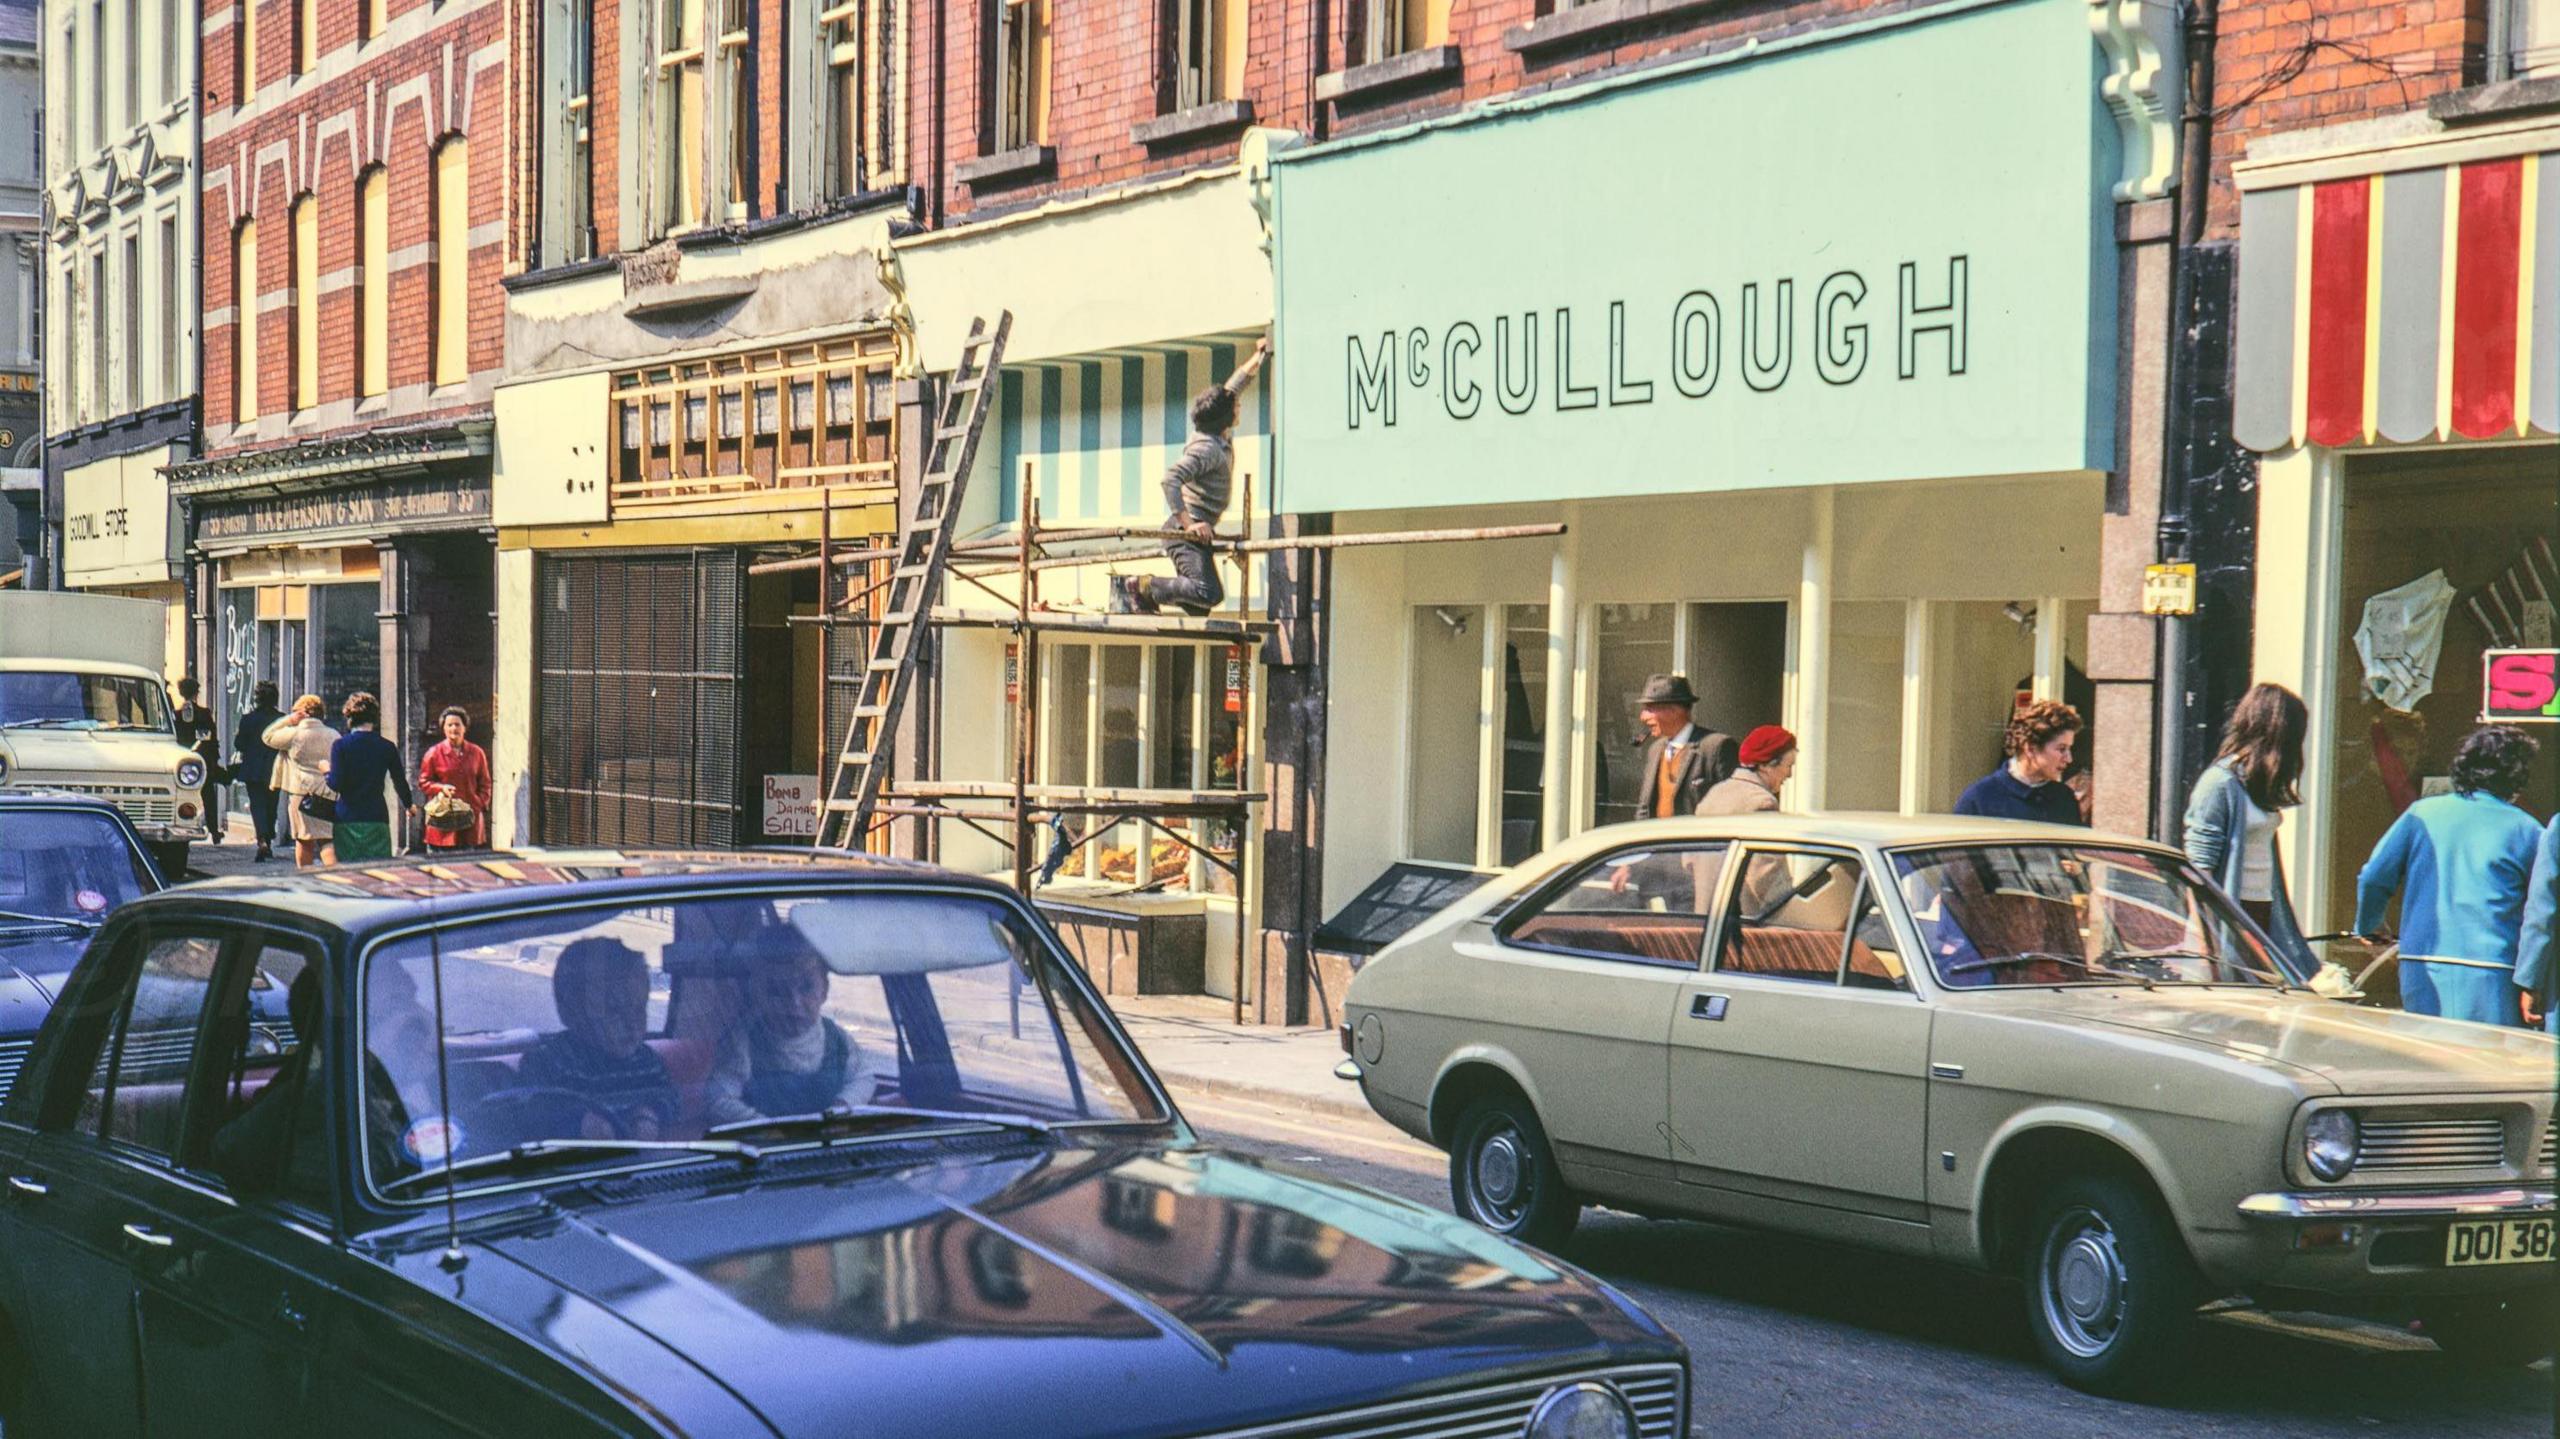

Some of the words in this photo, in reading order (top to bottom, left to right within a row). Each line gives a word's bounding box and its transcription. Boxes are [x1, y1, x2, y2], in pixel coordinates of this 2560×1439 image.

[349, 489, 374, 523] SON
[105, 508, 128, 536] STORE
[776, 801, 817, 815] DAMAG
[766, 816, 812, 833] SALE
[2453, 1223, 2504, 1262] DOI
